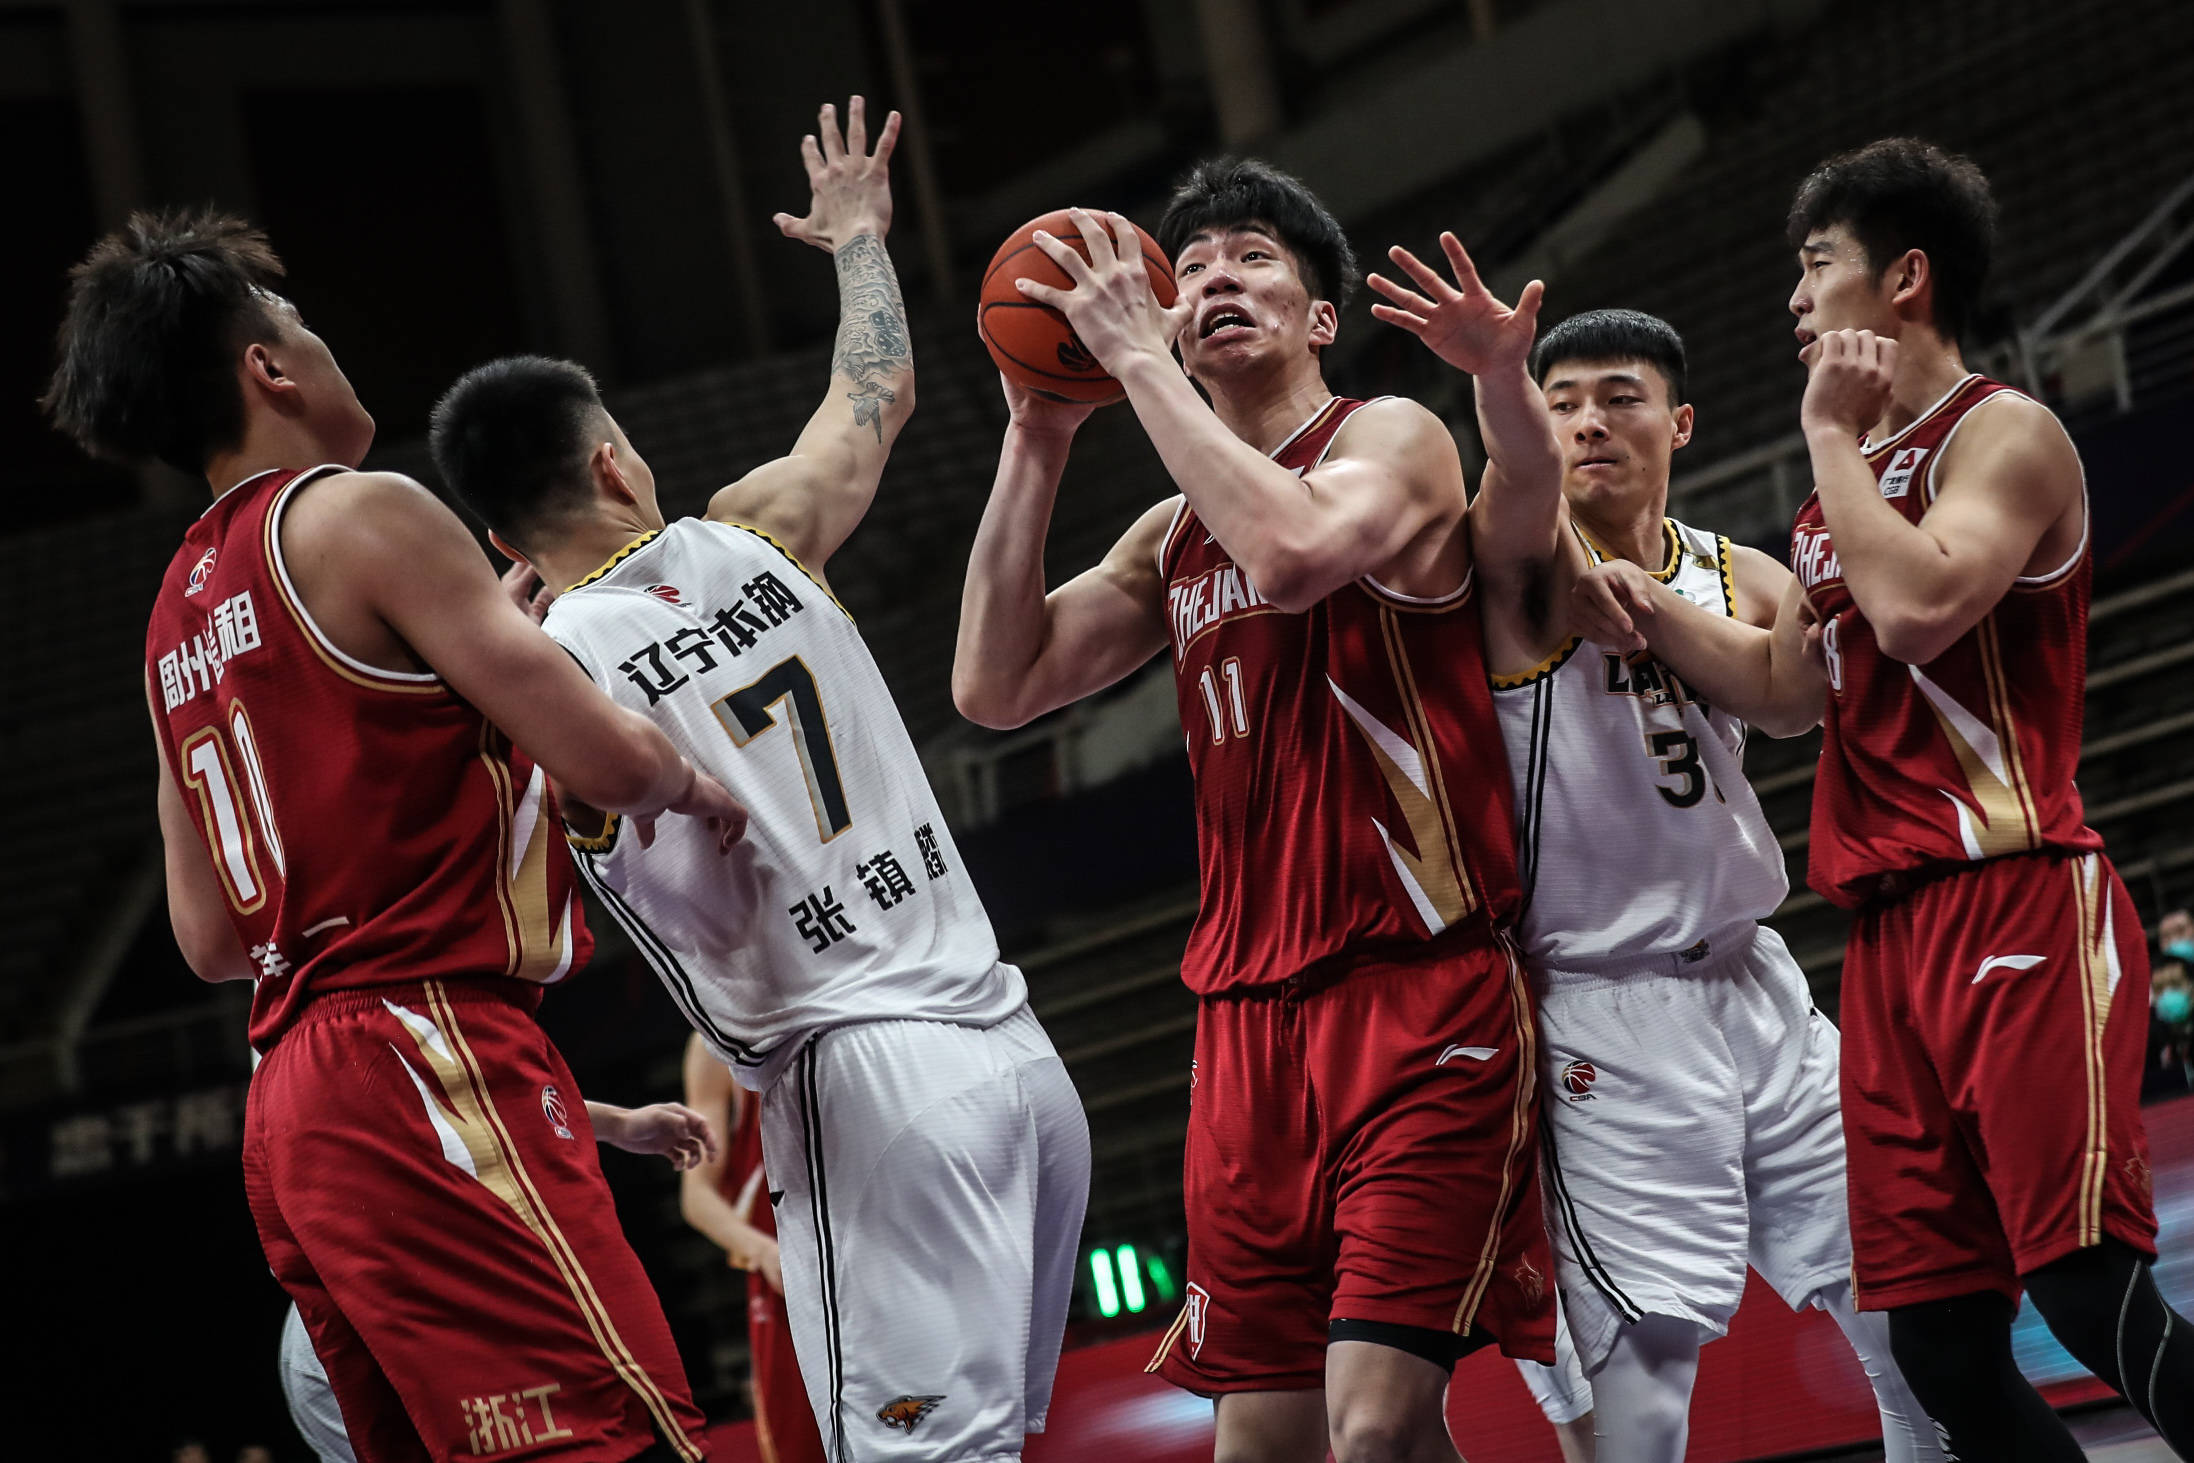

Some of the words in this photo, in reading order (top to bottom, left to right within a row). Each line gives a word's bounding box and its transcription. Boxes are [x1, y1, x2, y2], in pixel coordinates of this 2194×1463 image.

[617, 571, 804, 707] 辽宁本钢
[711, 654, 852, 844] 7
[1200, 656, 1249, 746] 11
[181, 697, 286, 916] 10
[1644, 729, 1725, 808] 3
[460, 1382, 573, 1456] 浙江
